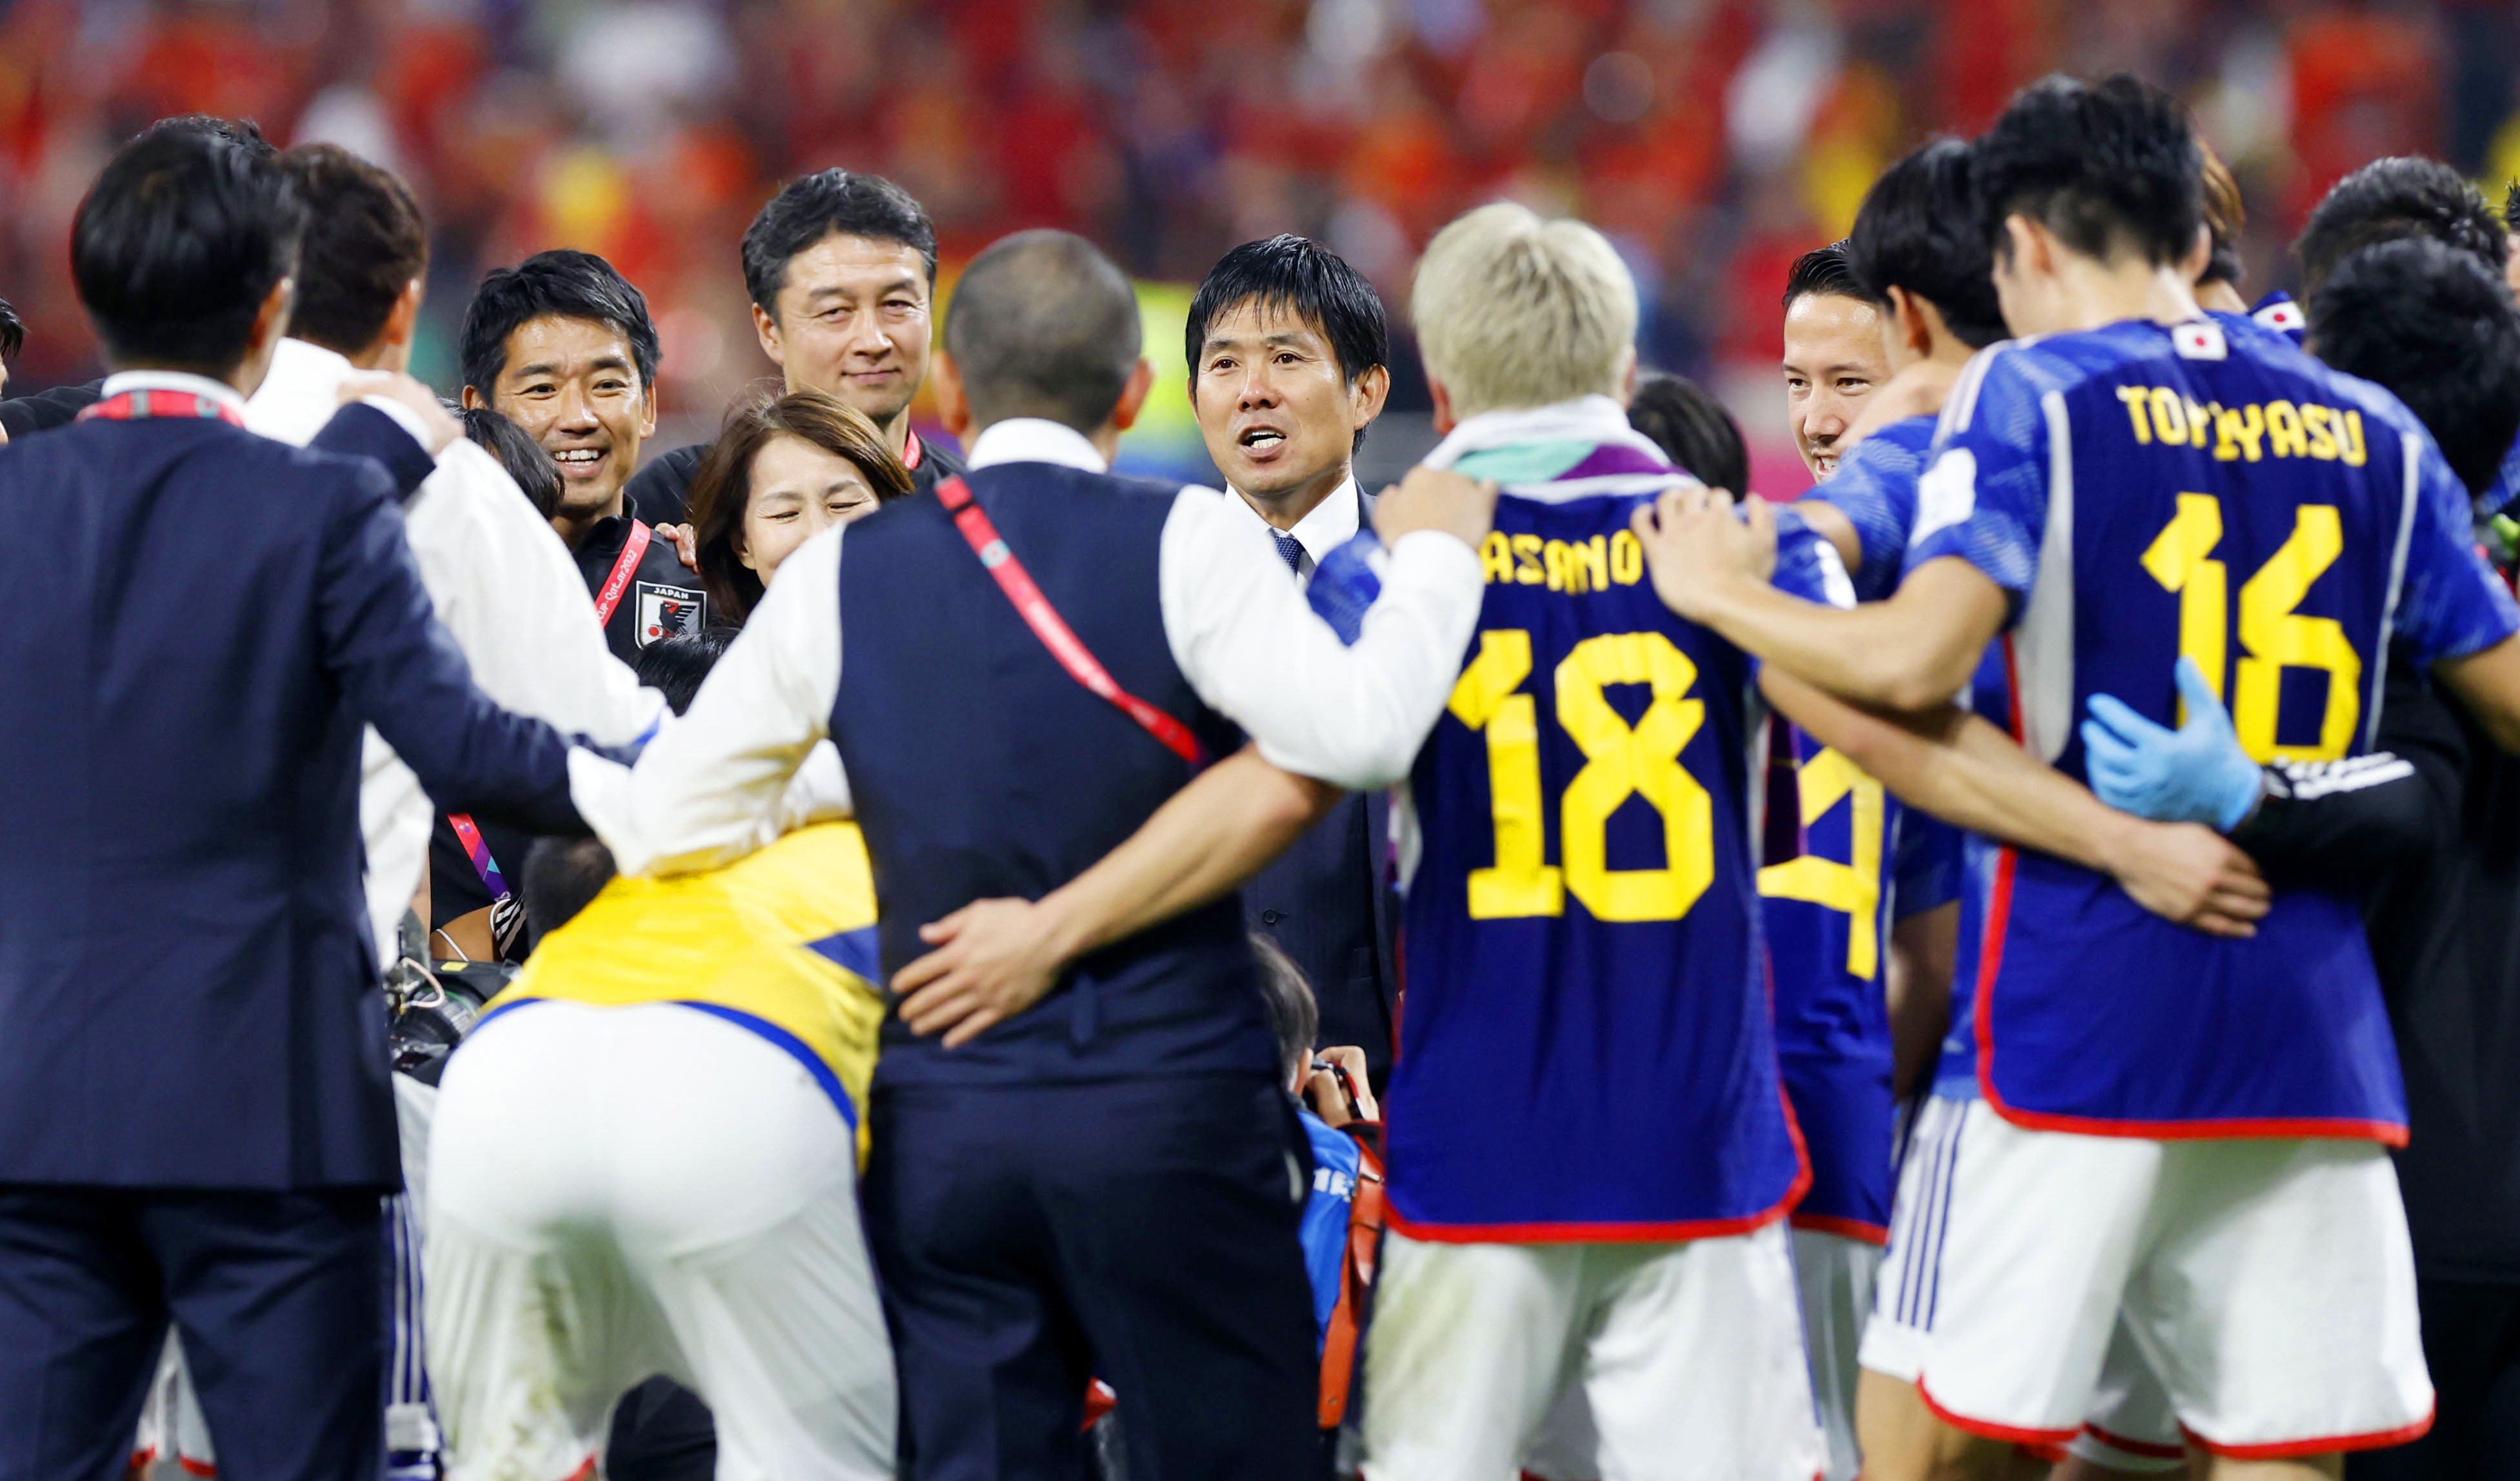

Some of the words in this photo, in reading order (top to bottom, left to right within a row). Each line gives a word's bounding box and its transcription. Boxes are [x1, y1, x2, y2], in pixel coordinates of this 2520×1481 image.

[654, 587, 688, 599] JAPAN
[1479, 529, 1643, 595] ASANO
[2140, 492, 2361, 762] 16
[1448, 629, 1715, 922] 18
